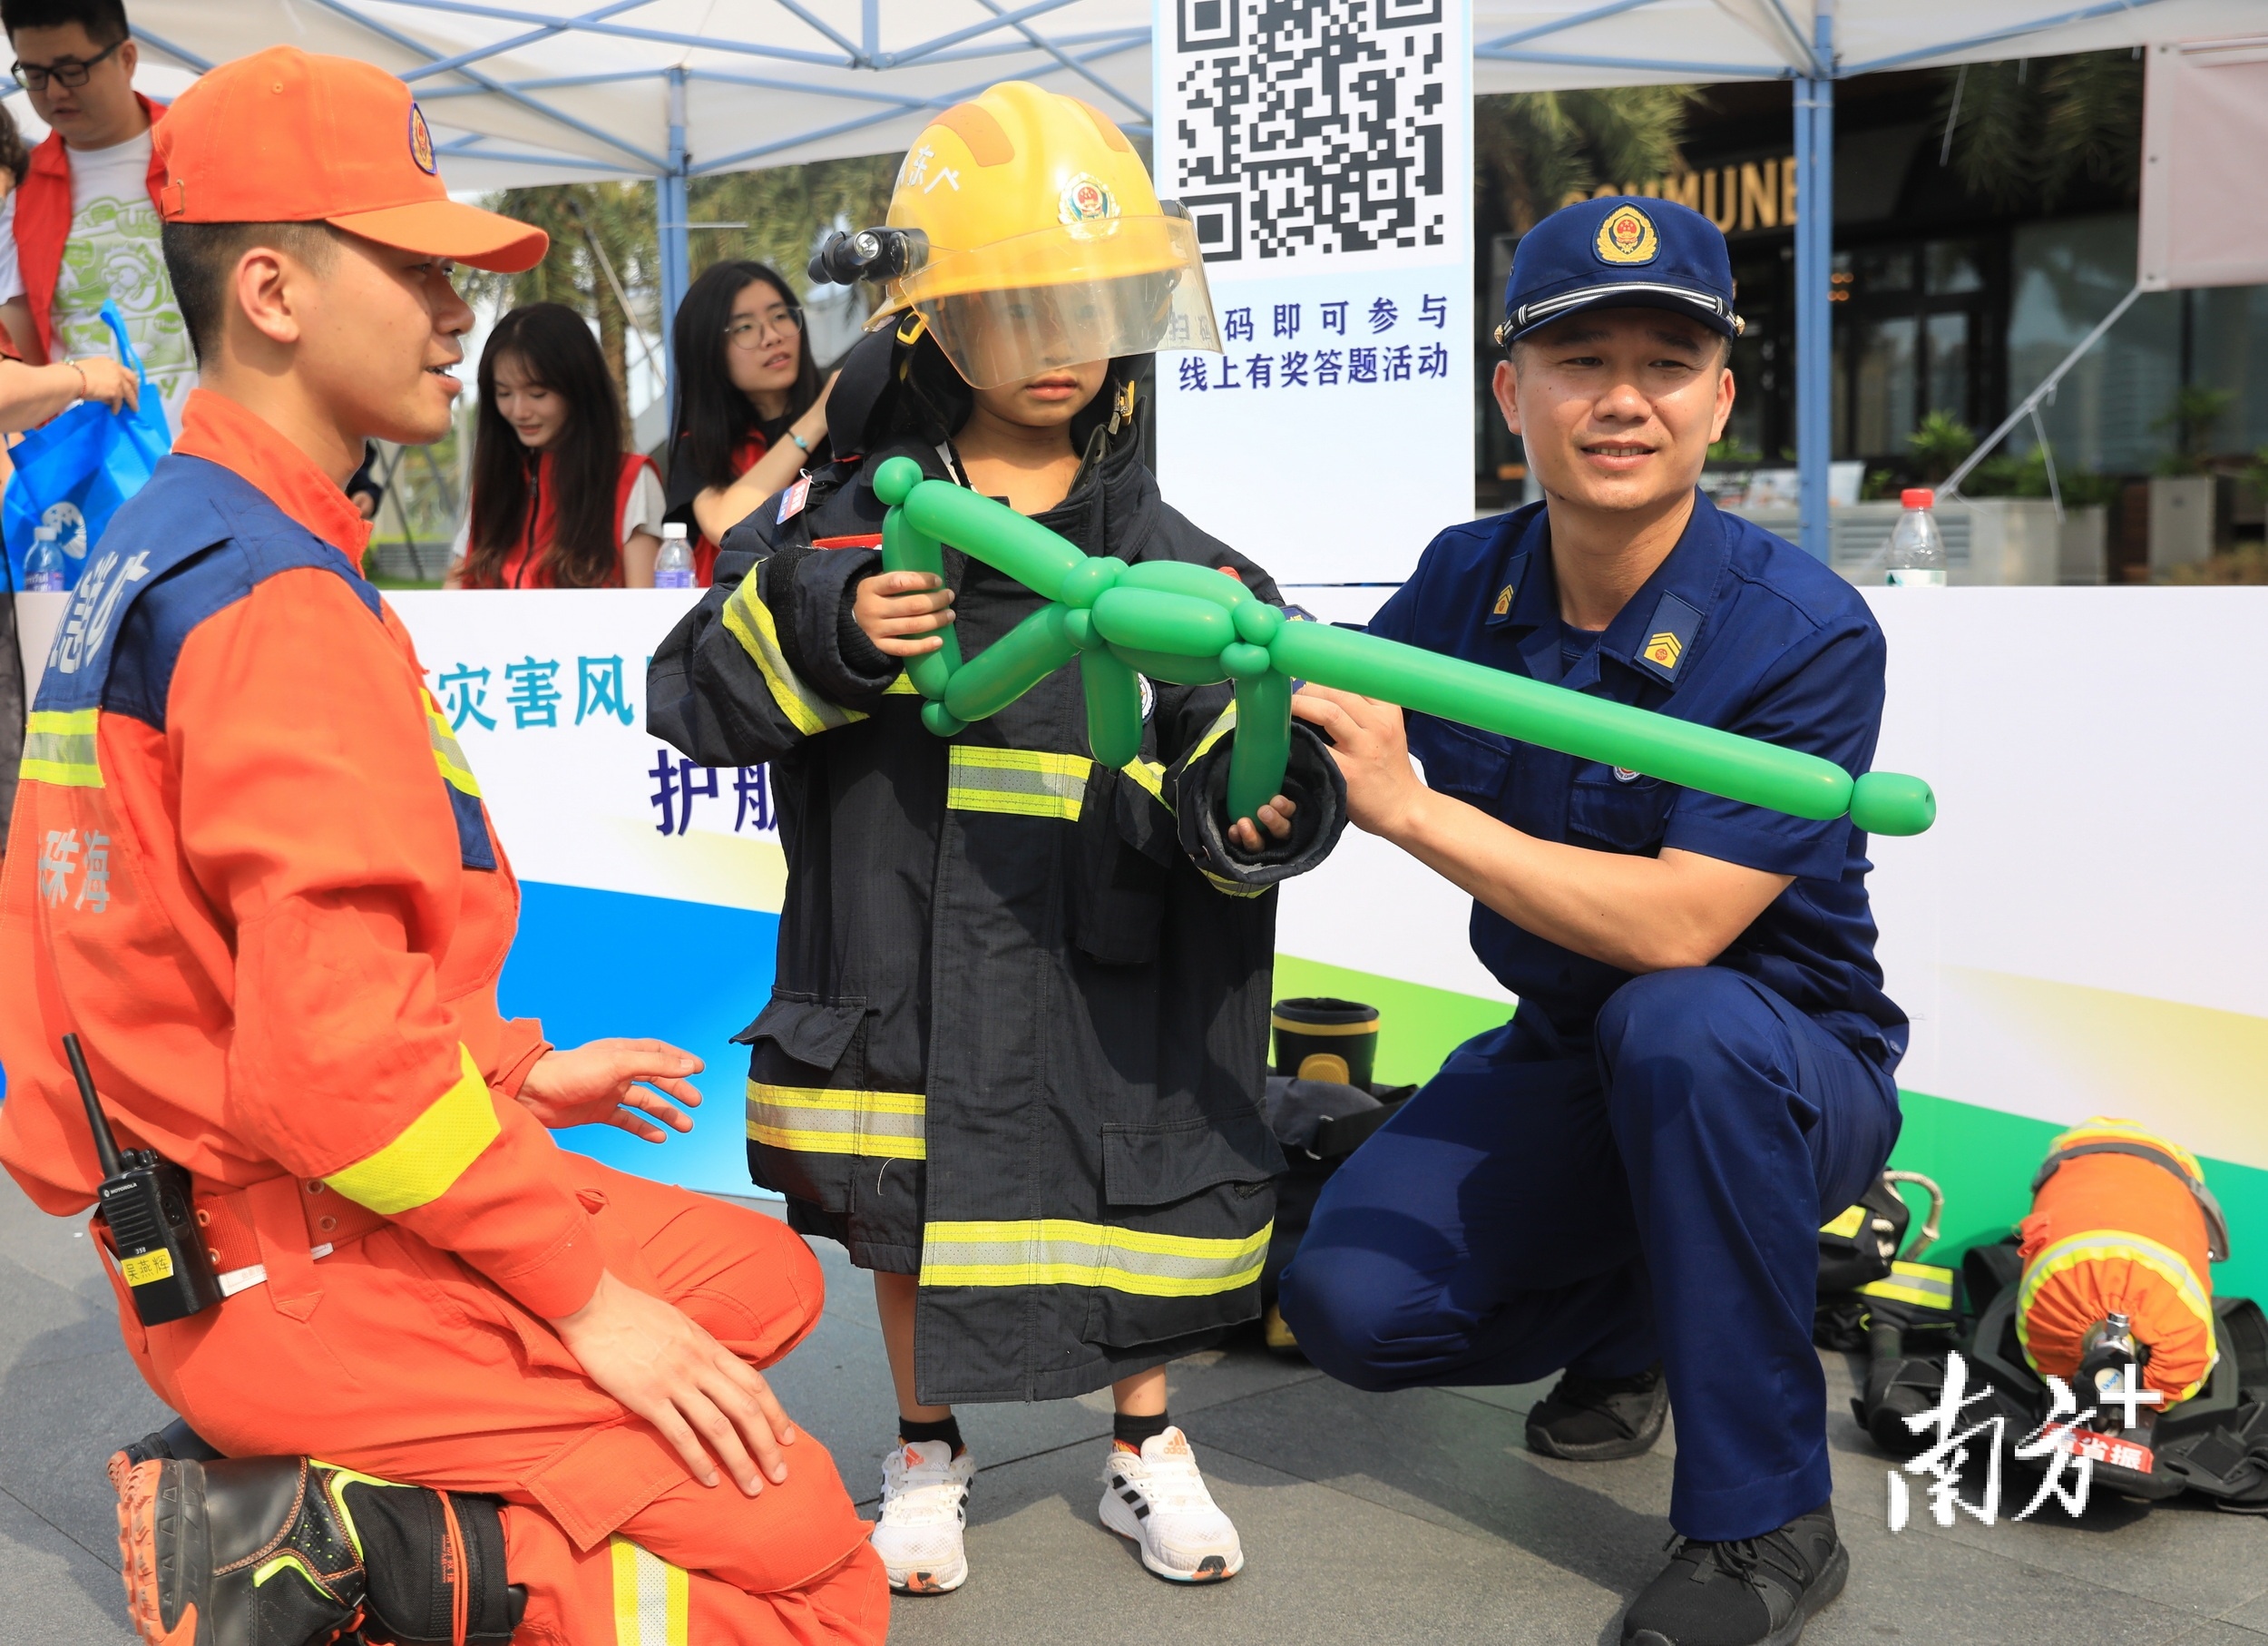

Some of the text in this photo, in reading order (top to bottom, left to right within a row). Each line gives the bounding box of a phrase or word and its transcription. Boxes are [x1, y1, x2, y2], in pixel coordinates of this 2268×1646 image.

[1178, 341, 1449, 392] 线上有奖答题活动
[438, 653, 653, 733] 灾害风
[38, 828, 111, 914] 珠海
[110, 1182, 138, 1195] MOTOROLA
[126, 1254, 171, 1281] 吴燕辉
